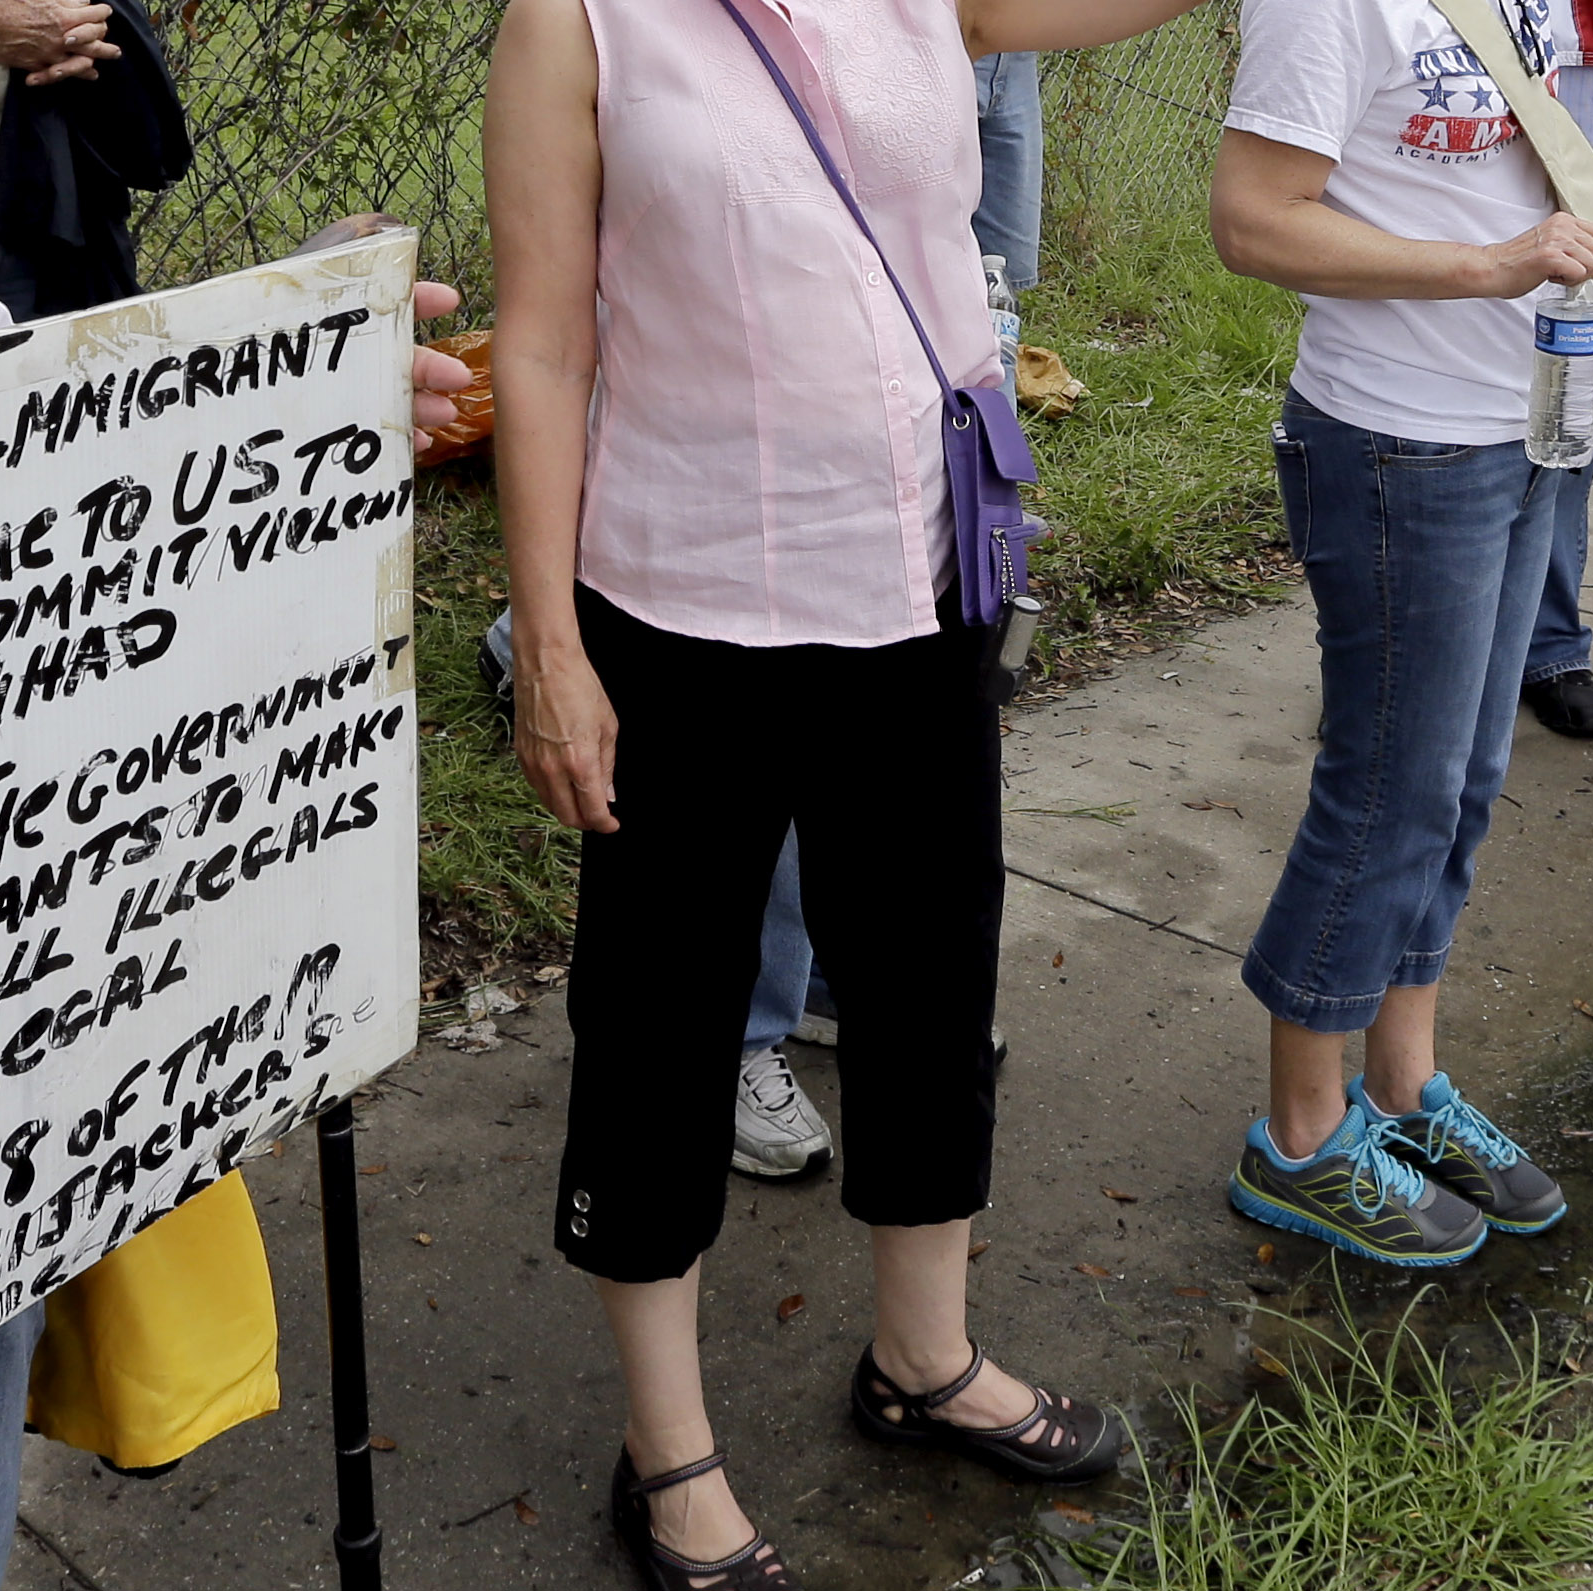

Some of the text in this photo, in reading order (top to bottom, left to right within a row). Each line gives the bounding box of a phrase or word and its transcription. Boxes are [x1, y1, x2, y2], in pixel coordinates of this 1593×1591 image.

[1395, 144, 1490, 165] ACADEMY
[74, 475, 152, 558] TO
[173, 429, 285, 526] US
[295, 423, 382, 496] TO
[192, 773, 244, 838] TO
[67, 1058, 150, 1157] OF
